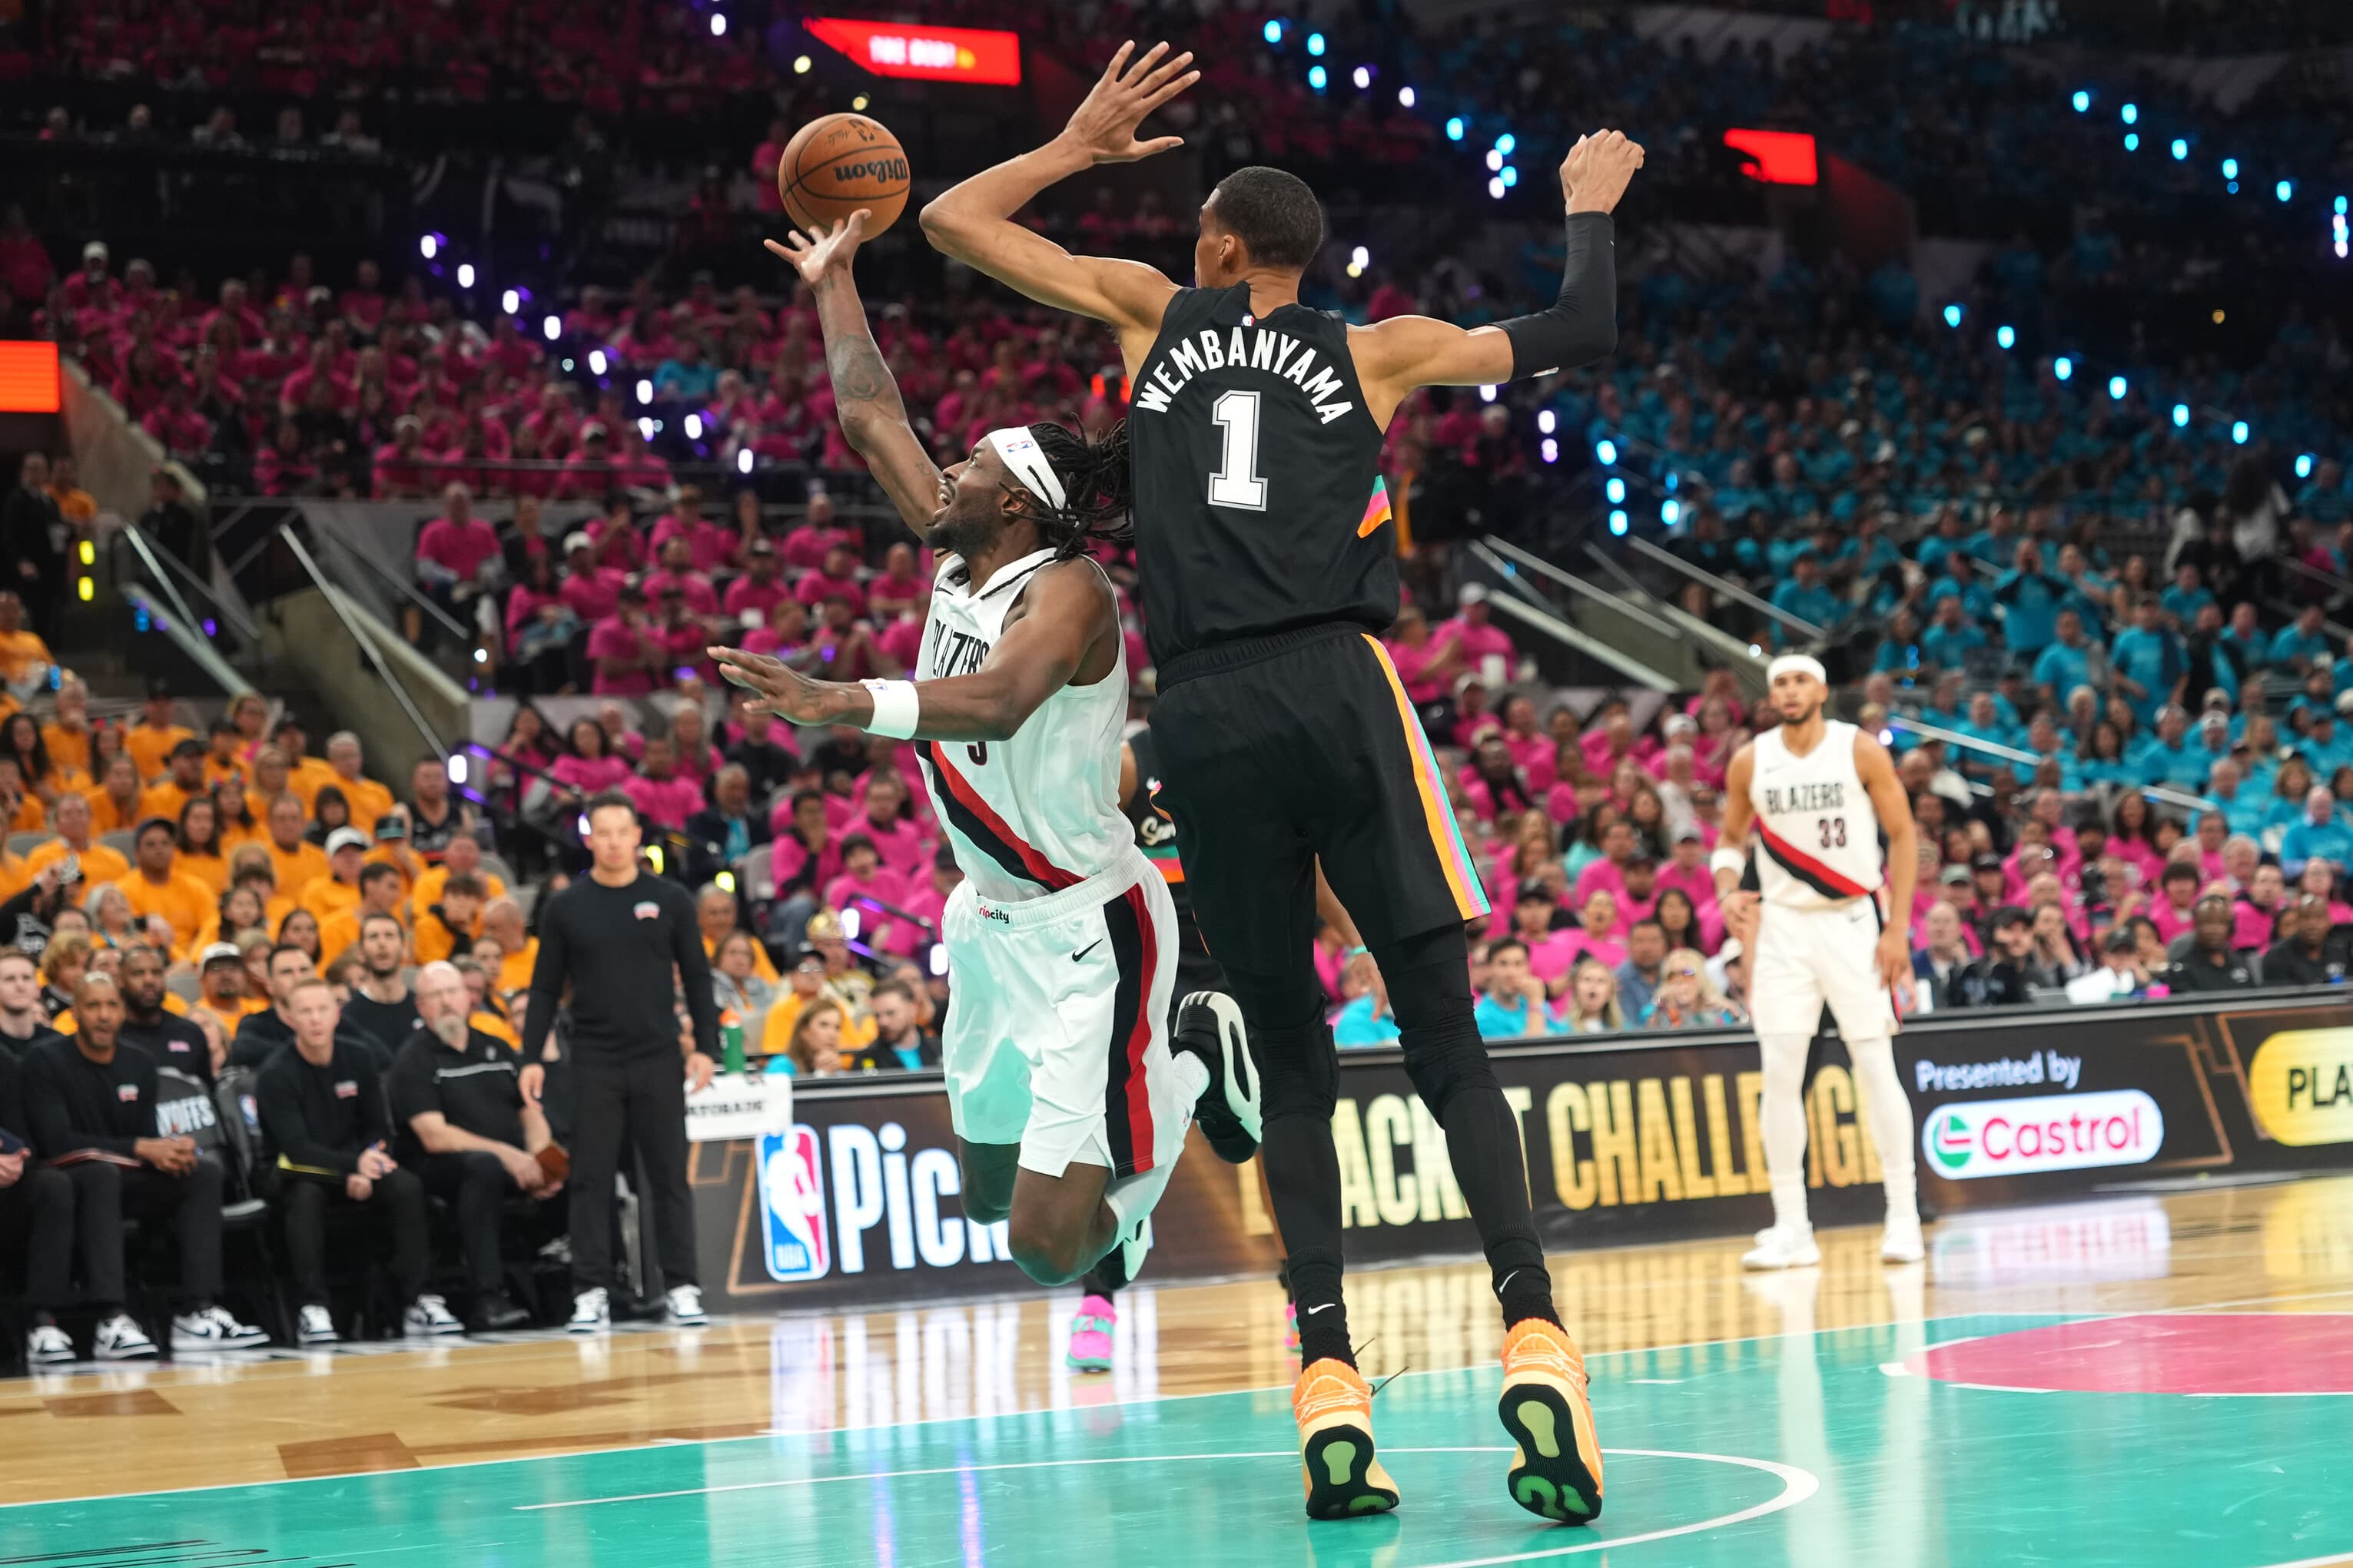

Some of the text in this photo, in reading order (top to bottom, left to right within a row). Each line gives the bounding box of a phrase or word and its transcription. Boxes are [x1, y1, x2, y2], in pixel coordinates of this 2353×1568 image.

[834, 157, 909, 184] Wilson
[1136, 326, 1353, 425] WEMBANYAMA
[1207, 390, 1268, 512] 1
[1766, 782, 1844, 815] BLAZERS
[1818, 817, 1847, 850] 33
[978, 905, 1010, 924] ripcity
[1915, 1049, 2082, 1092] Presented by
[2287, 1064, 2353, 1110] PLA
[686, 1099, 764, 1118] ATORADE
[1982, 1107, 2142, 1161] Castrol
